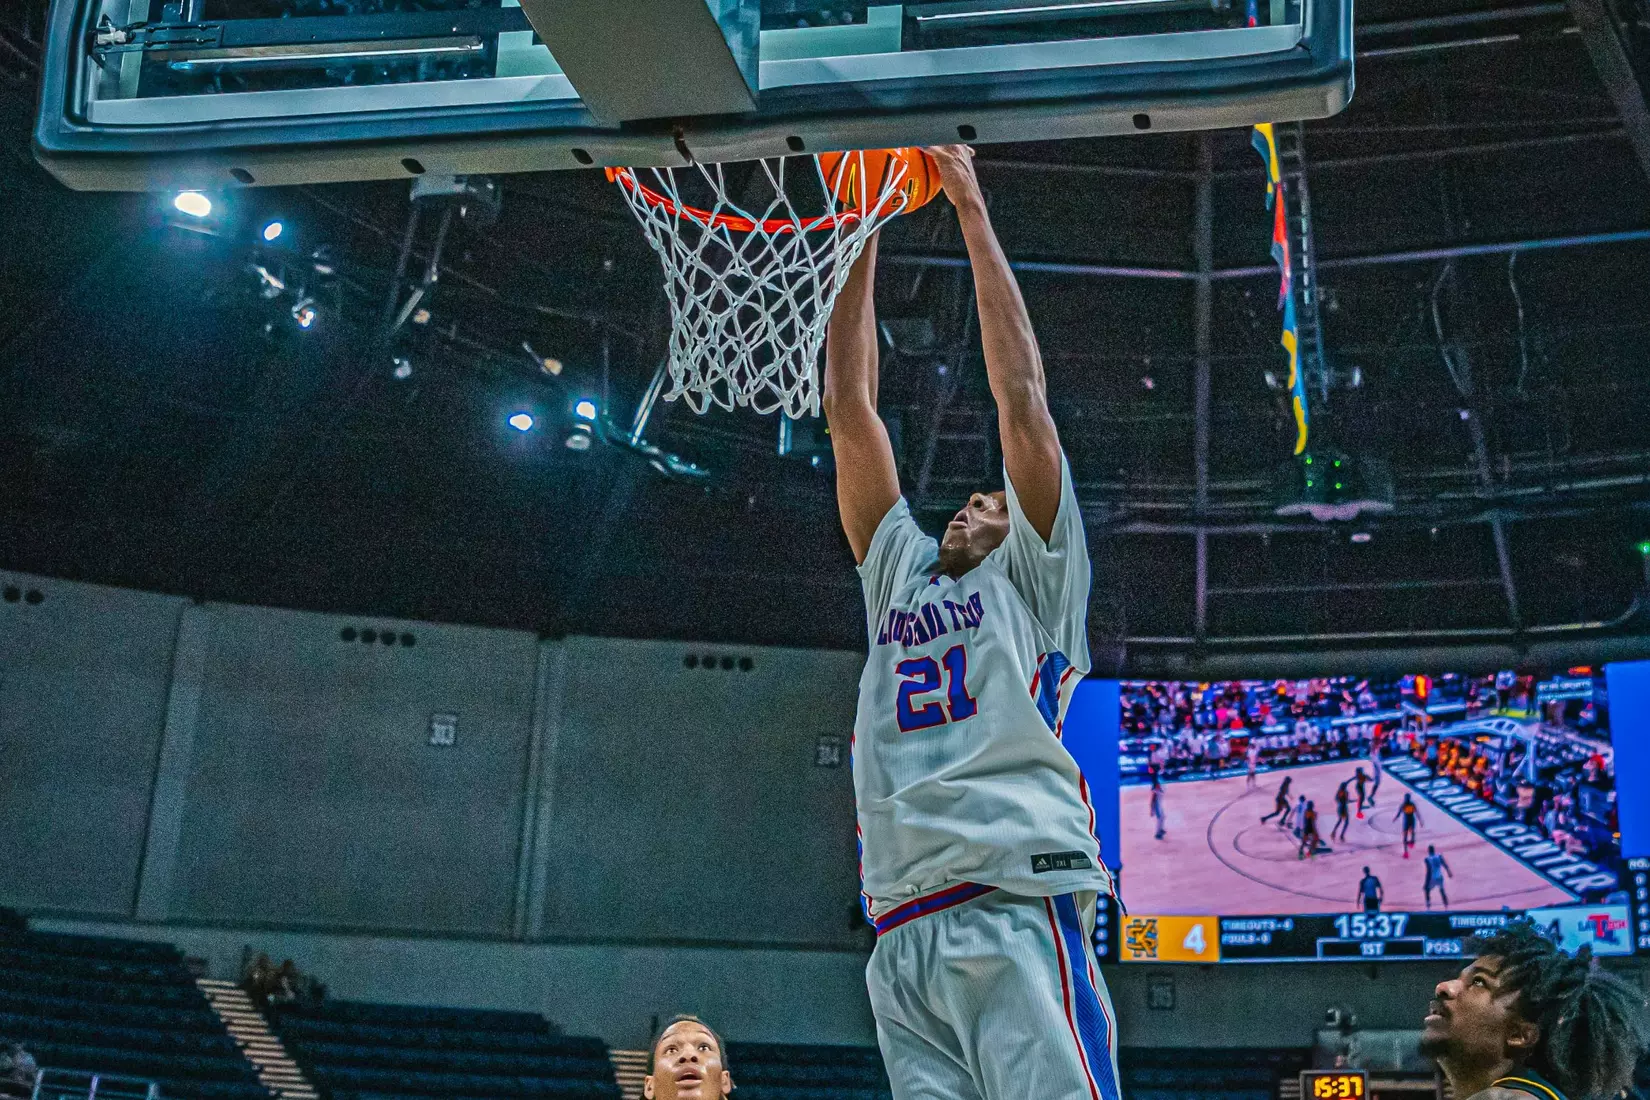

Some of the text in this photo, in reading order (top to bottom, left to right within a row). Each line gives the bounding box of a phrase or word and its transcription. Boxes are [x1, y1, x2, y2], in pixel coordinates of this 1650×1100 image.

[895, 644, 978, 733] 21
[1484, 821, 1617, 893] CENTER
[1183, 923, 1207, 954] 4
[1334, 914, 1408, 938] 15:37
[1314, 1076, 1363, 1098] 15:37
